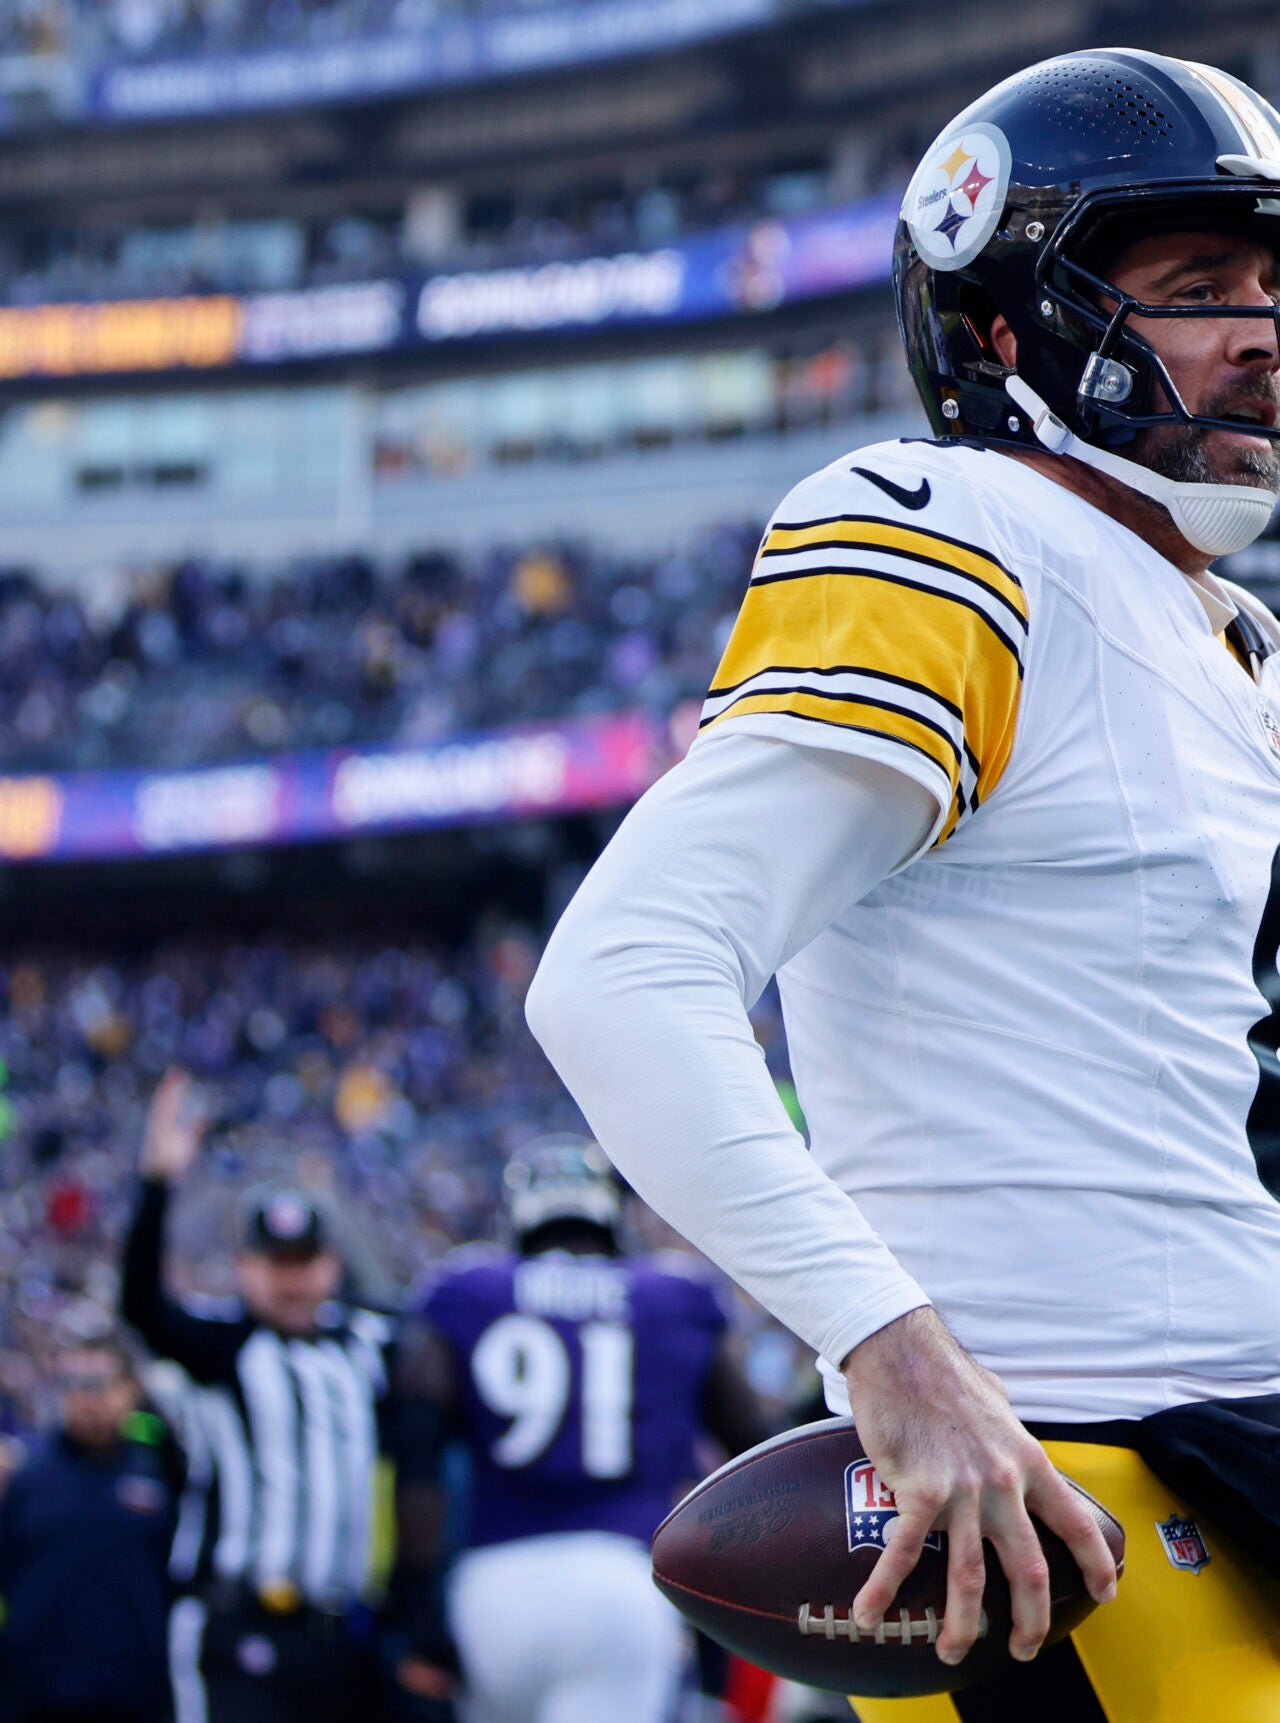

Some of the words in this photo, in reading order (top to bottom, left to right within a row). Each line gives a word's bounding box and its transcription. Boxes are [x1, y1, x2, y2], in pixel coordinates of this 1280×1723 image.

[918, 188, 947, 210] Steelers
[470, 1311, 634, 1480] 91
[1171, 1538, 1205, 1562] NFL
